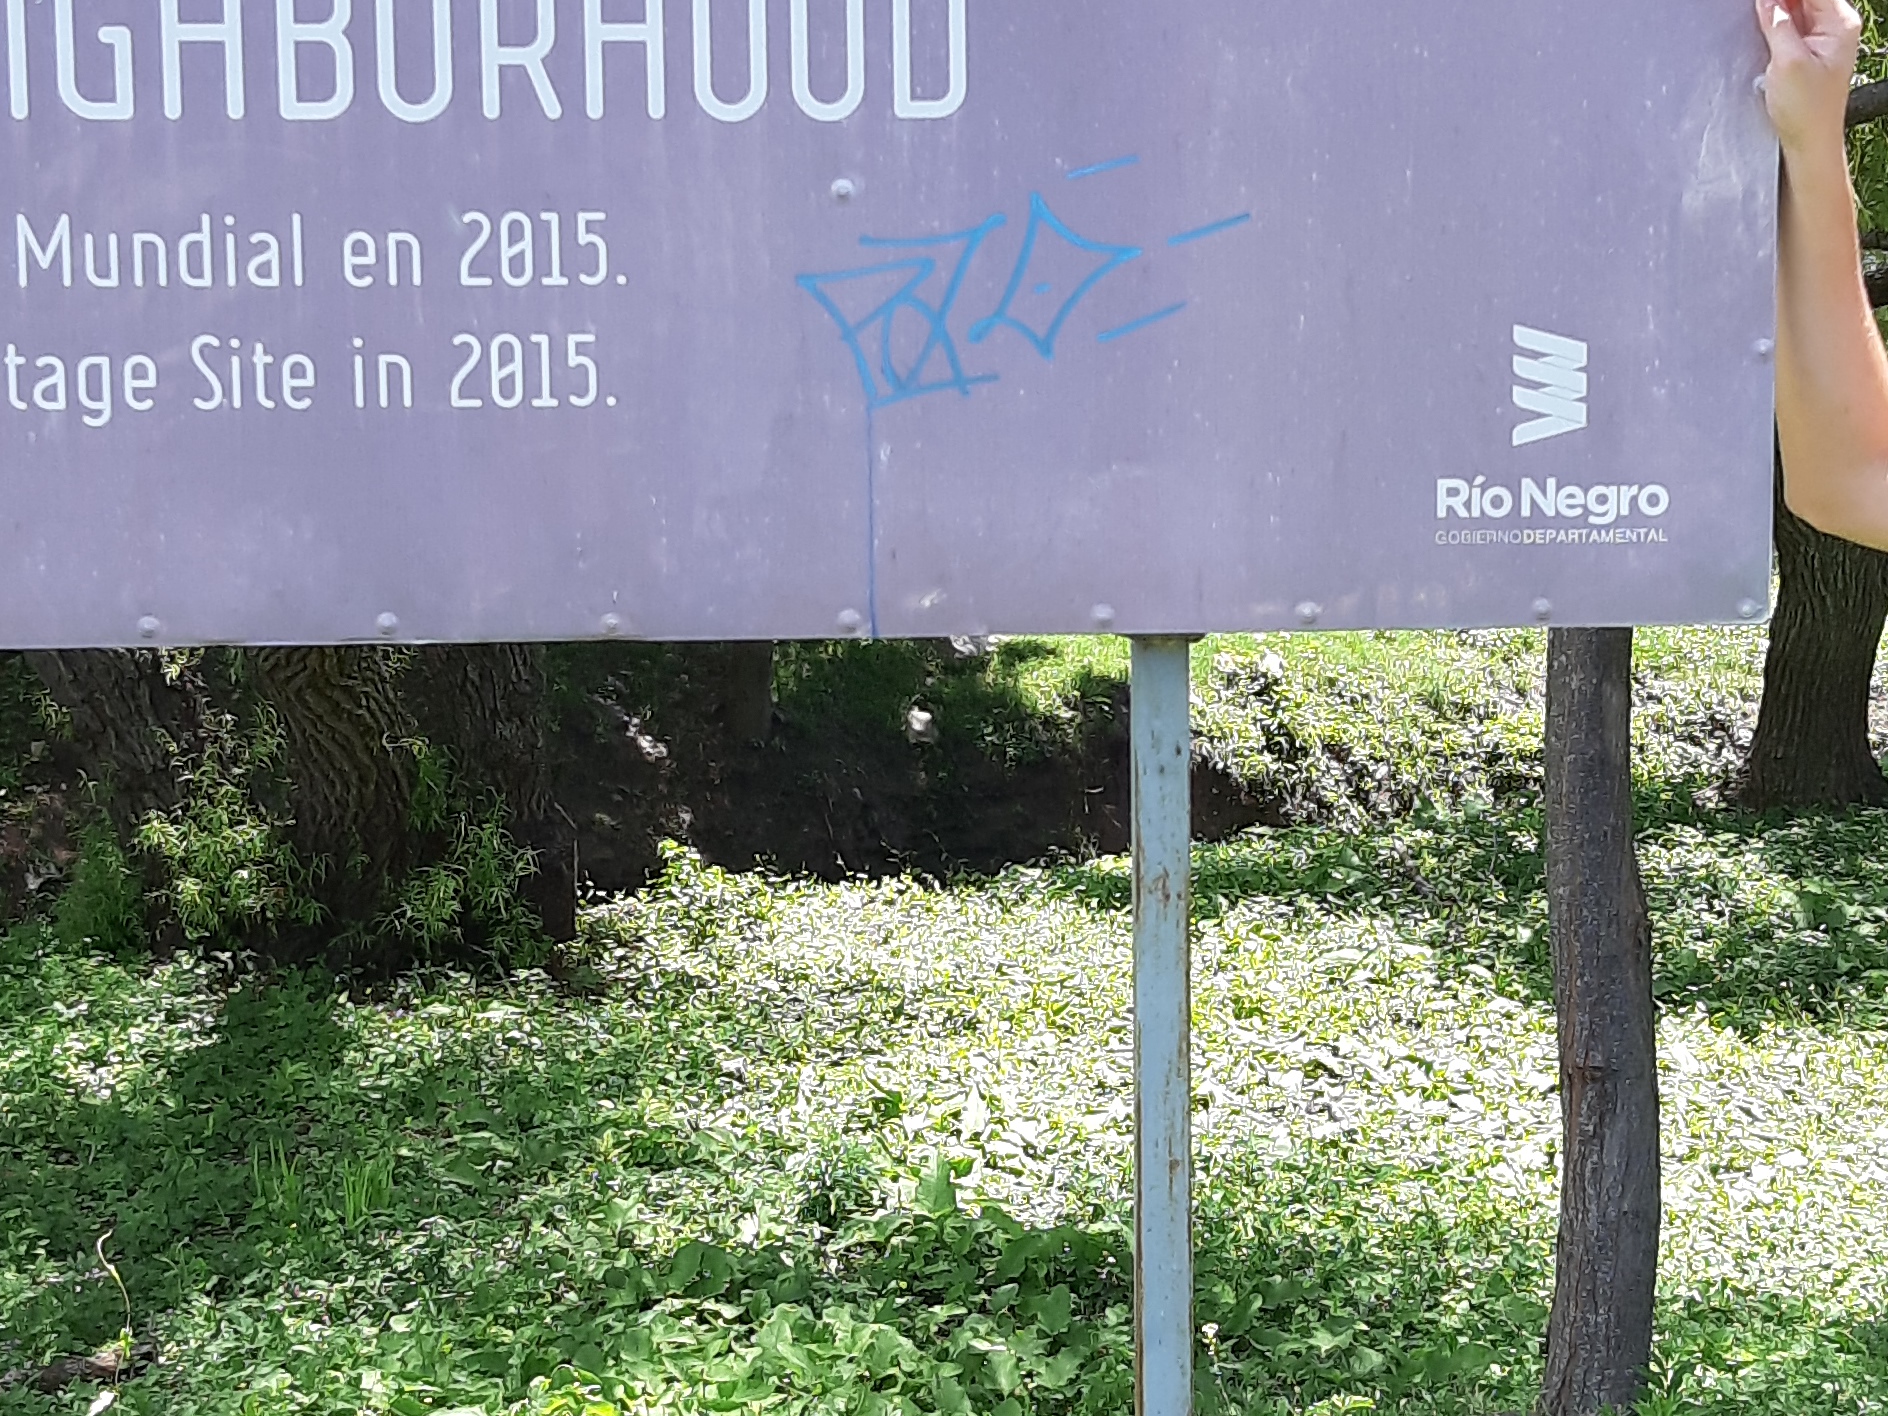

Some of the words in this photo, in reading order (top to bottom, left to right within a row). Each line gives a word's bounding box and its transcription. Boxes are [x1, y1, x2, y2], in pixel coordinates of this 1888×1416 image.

[15, 212, 306, 290] Mundial
[342, 230, 424, 289] en
[459, 210, 629, 288] 2015.
[190, 334, 317, 411] Site
[351, 337, 414, 410] in
[449, 333, 618, 410] 2015.
[1435, 474, 1513, 519] Río
[1520, 476, 1671, 525] Negro
